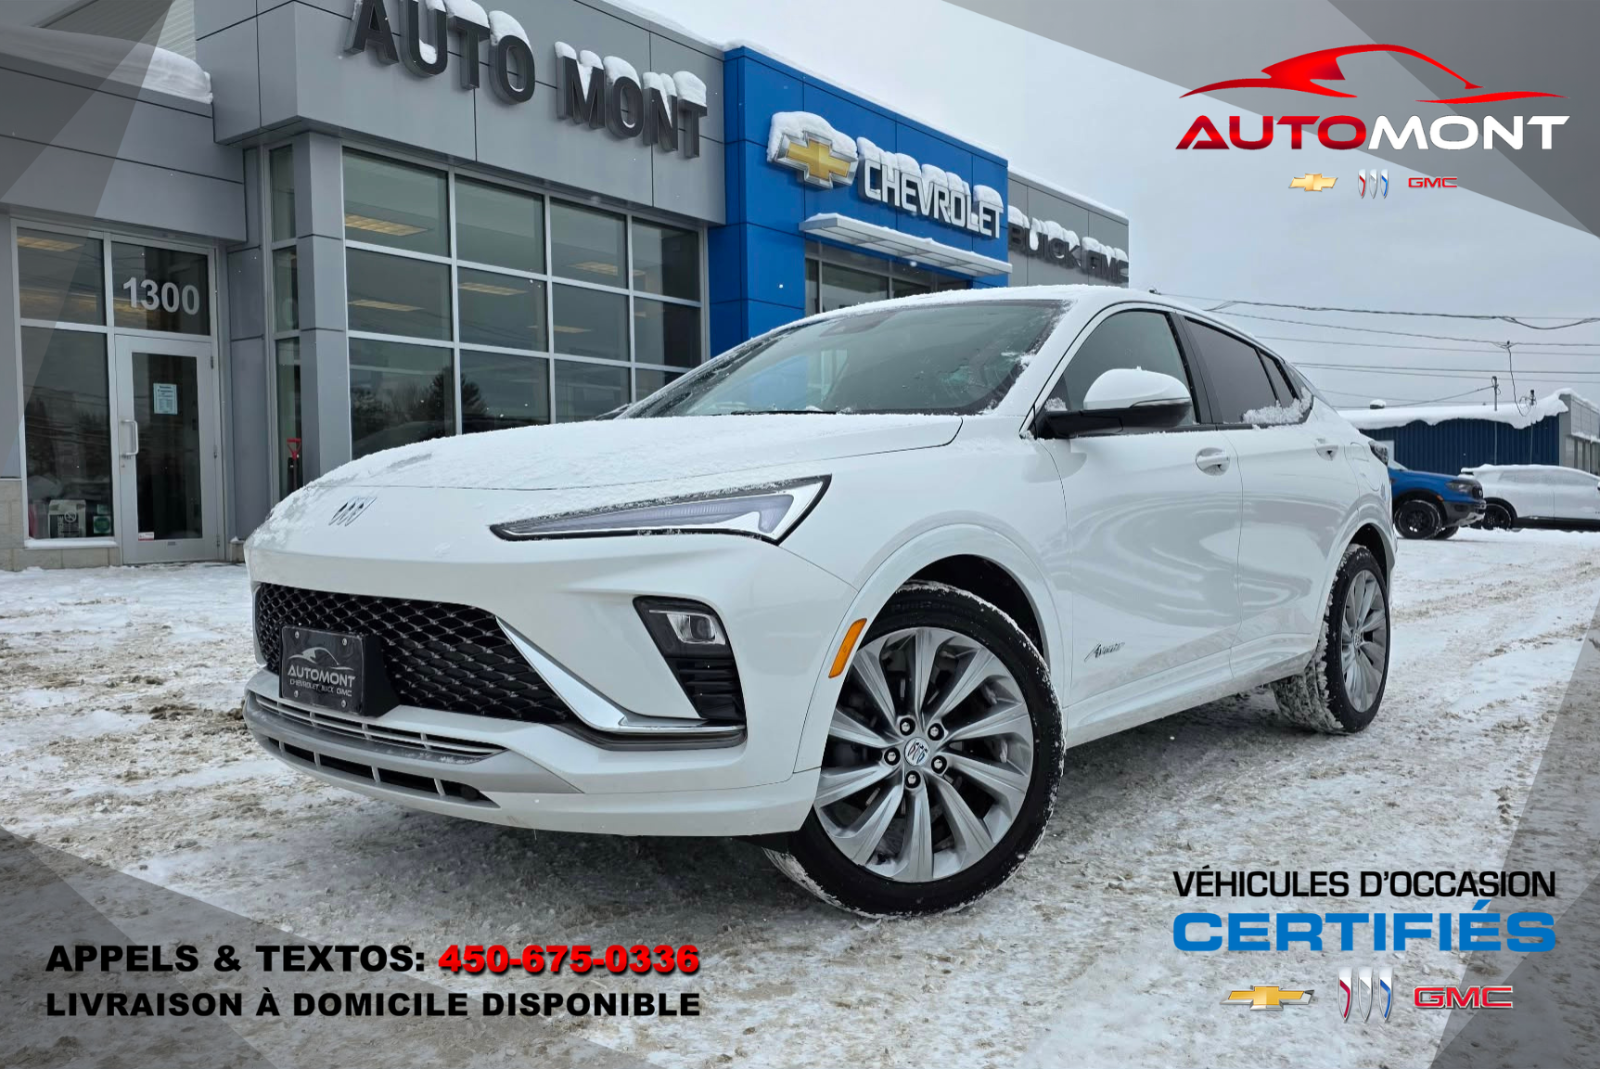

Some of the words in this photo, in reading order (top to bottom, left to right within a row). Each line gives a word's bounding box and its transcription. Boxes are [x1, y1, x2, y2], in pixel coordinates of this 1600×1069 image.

[345, 0, 536, 105] AUTO
[556, 53, 708, 159] MONT
[861, 158, 1004, 239] CHEVROLET
[1008, 222, 1081, 270] BUICK
[1082, 248, 1129, 284] GMC
[122, 276, 200, 316] 1300
[287, 664, 356, 688] AUTOMONT
[336, 688, 353, 697] GMC
